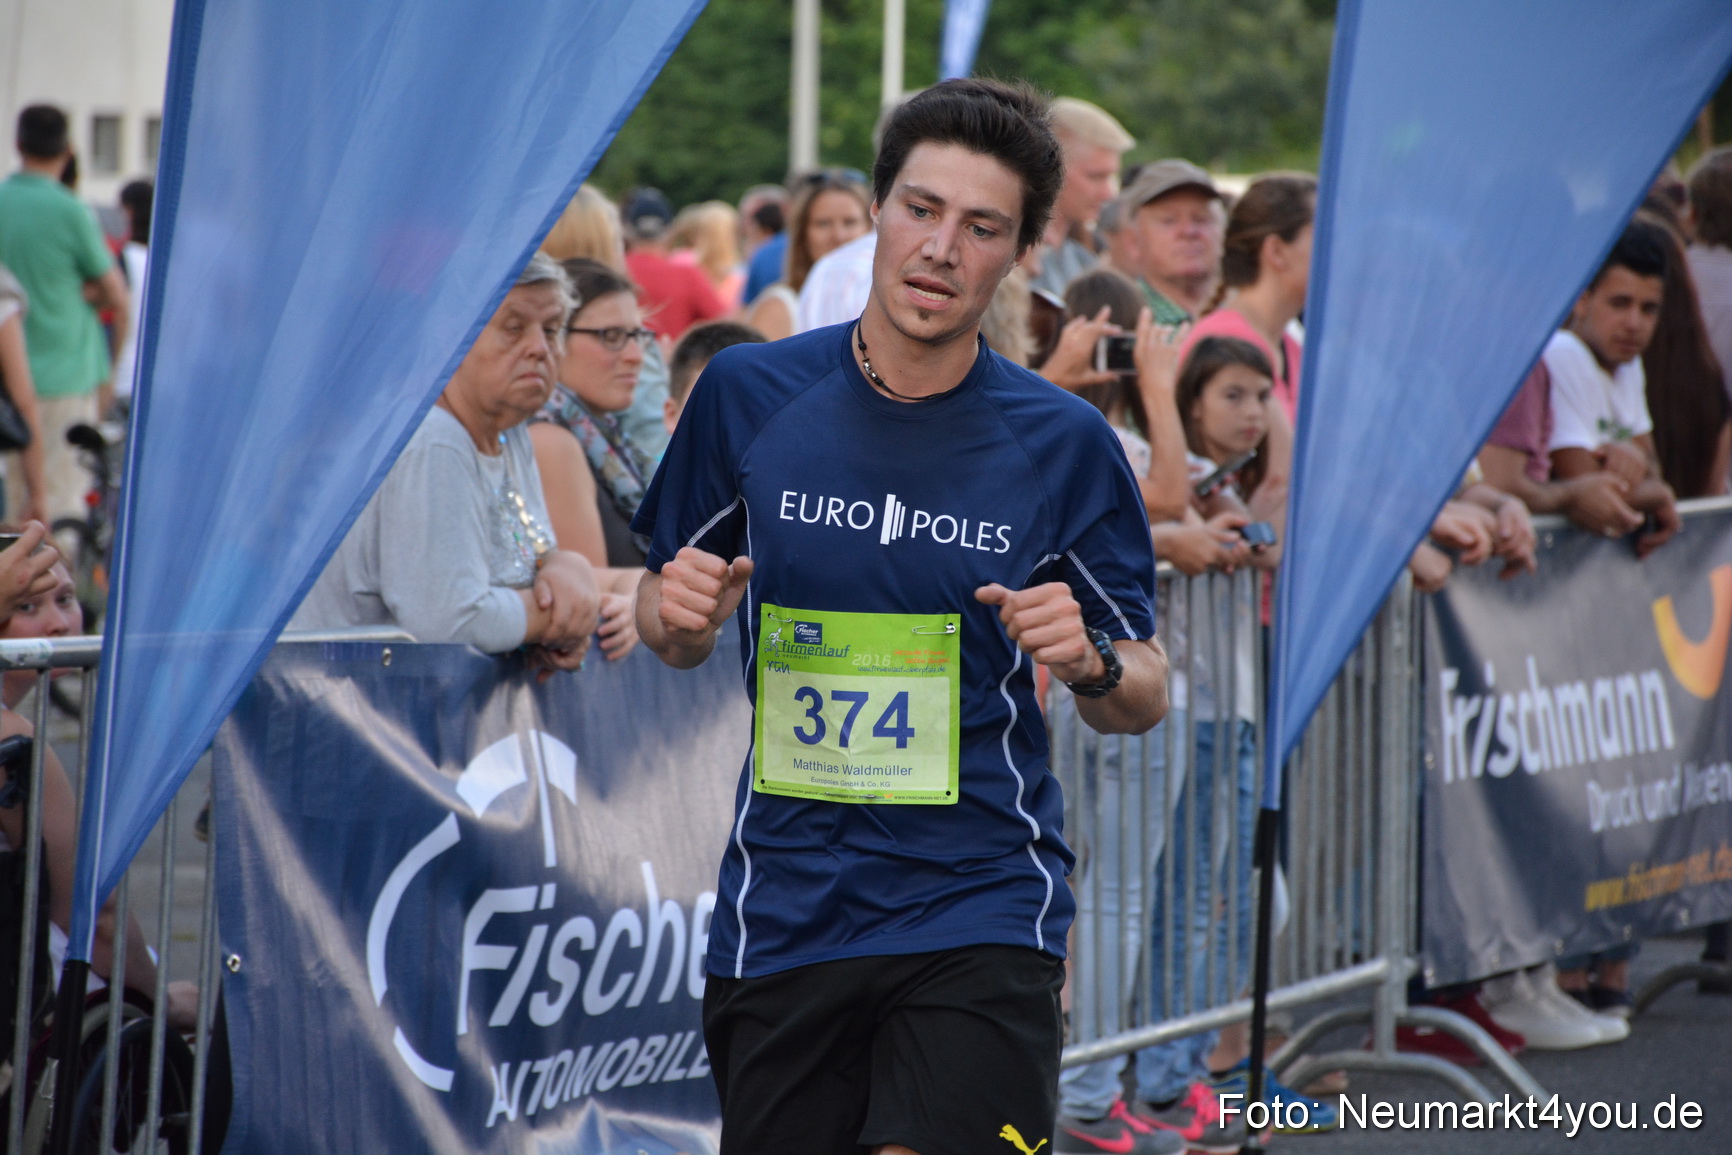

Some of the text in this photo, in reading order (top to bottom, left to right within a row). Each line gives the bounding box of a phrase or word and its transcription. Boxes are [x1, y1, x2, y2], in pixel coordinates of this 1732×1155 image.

[779, 490, 1012, 554] EURO POLES
[782, 640, 851, 658] firmenlauf
[851, 654, 892, 667] 2016
[793, 686, 915, 749] 374
[1440, 655, 1676, 784] Frischmann
[793, 758, 912, 776] Matthias Waldmüller
[810, 777, 839, 785] Europoles
